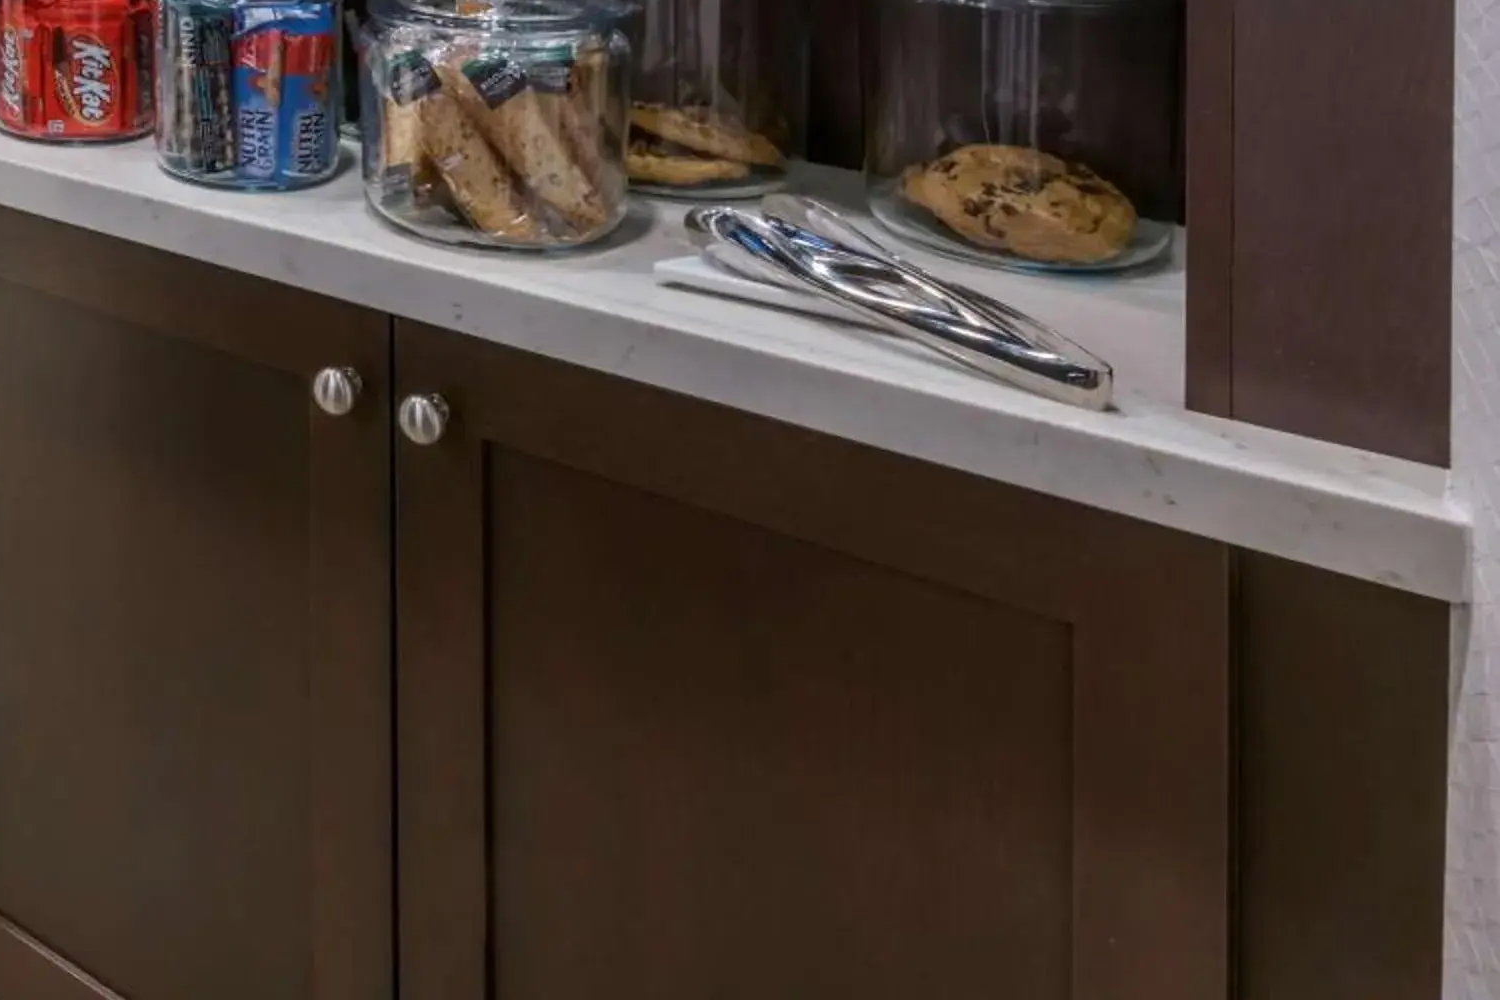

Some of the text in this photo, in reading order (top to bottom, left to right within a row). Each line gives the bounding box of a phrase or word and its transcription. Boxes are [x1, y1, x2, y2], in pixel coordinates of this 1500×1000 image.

[179, 16, 196, 68] KIND
[72, 38, 111, 120] KitKat
[241, 109, 255, 168] NUTRI
[255, 110, 276, 172] GRAIN
[298, 113, 313, 173] NUTRI
